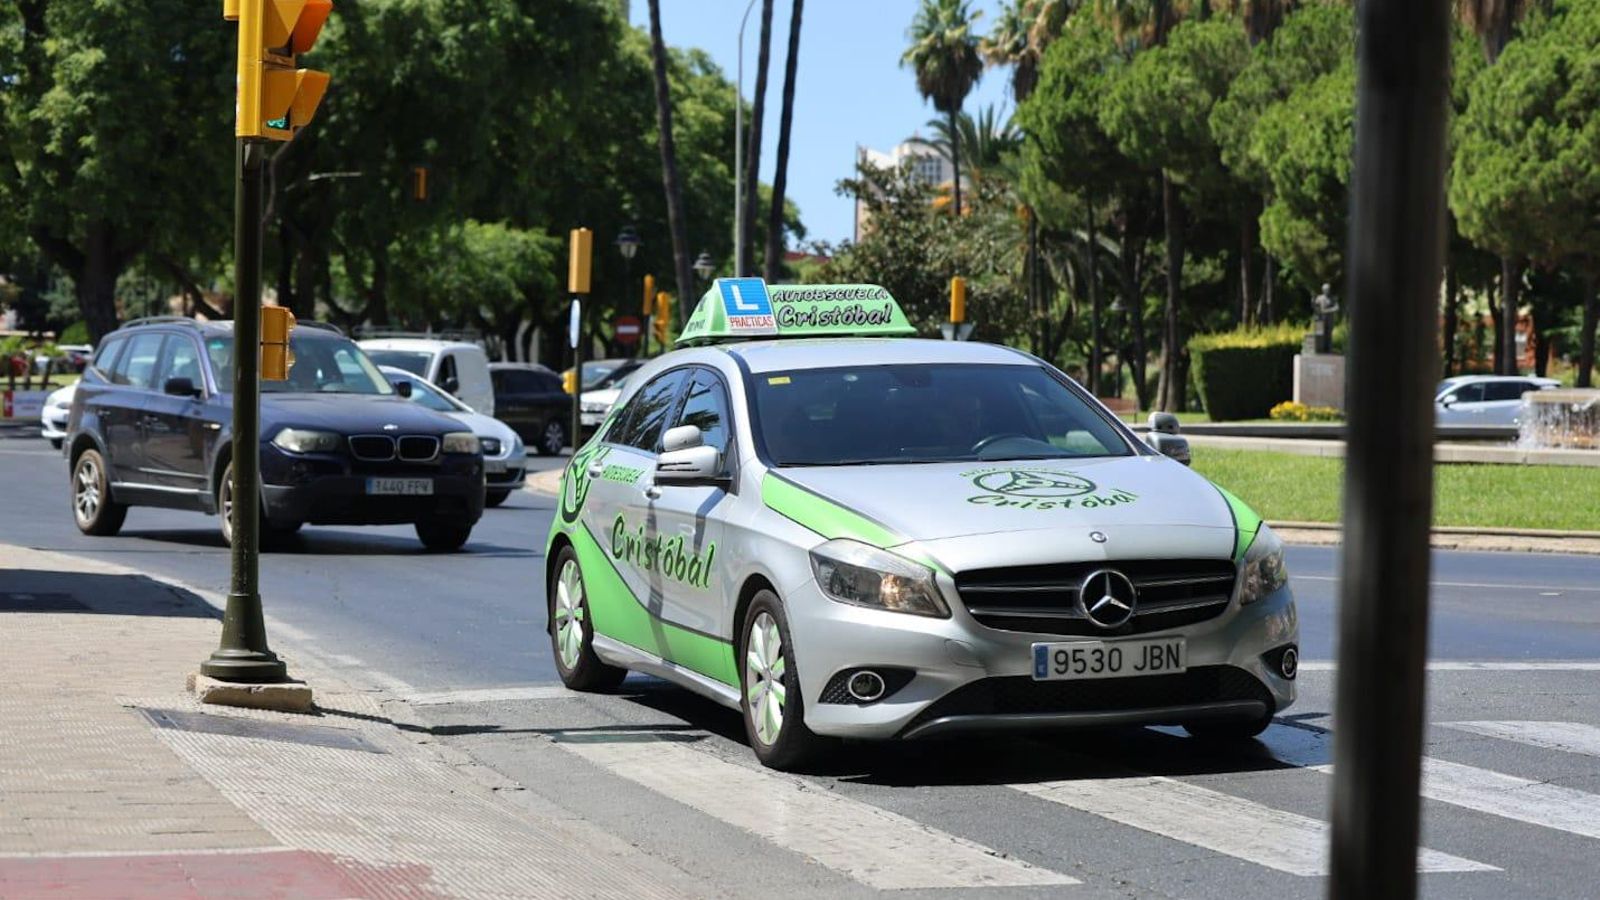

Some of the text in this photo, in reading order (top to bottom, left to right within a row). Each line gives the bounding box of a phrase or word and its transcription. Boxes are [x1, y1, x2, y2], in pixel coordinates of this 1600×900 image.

[731, 284, 760, 310] L
[773, 288, 888, 302] AUTOESCUELA
[778, 303, 893, 328] Cristóbal
[967, 488, 1139, 510] Cristóbal
[611, 514, 715, 588] Cristóbal
[1054, 643, 1180, 675] 9530 JBN
